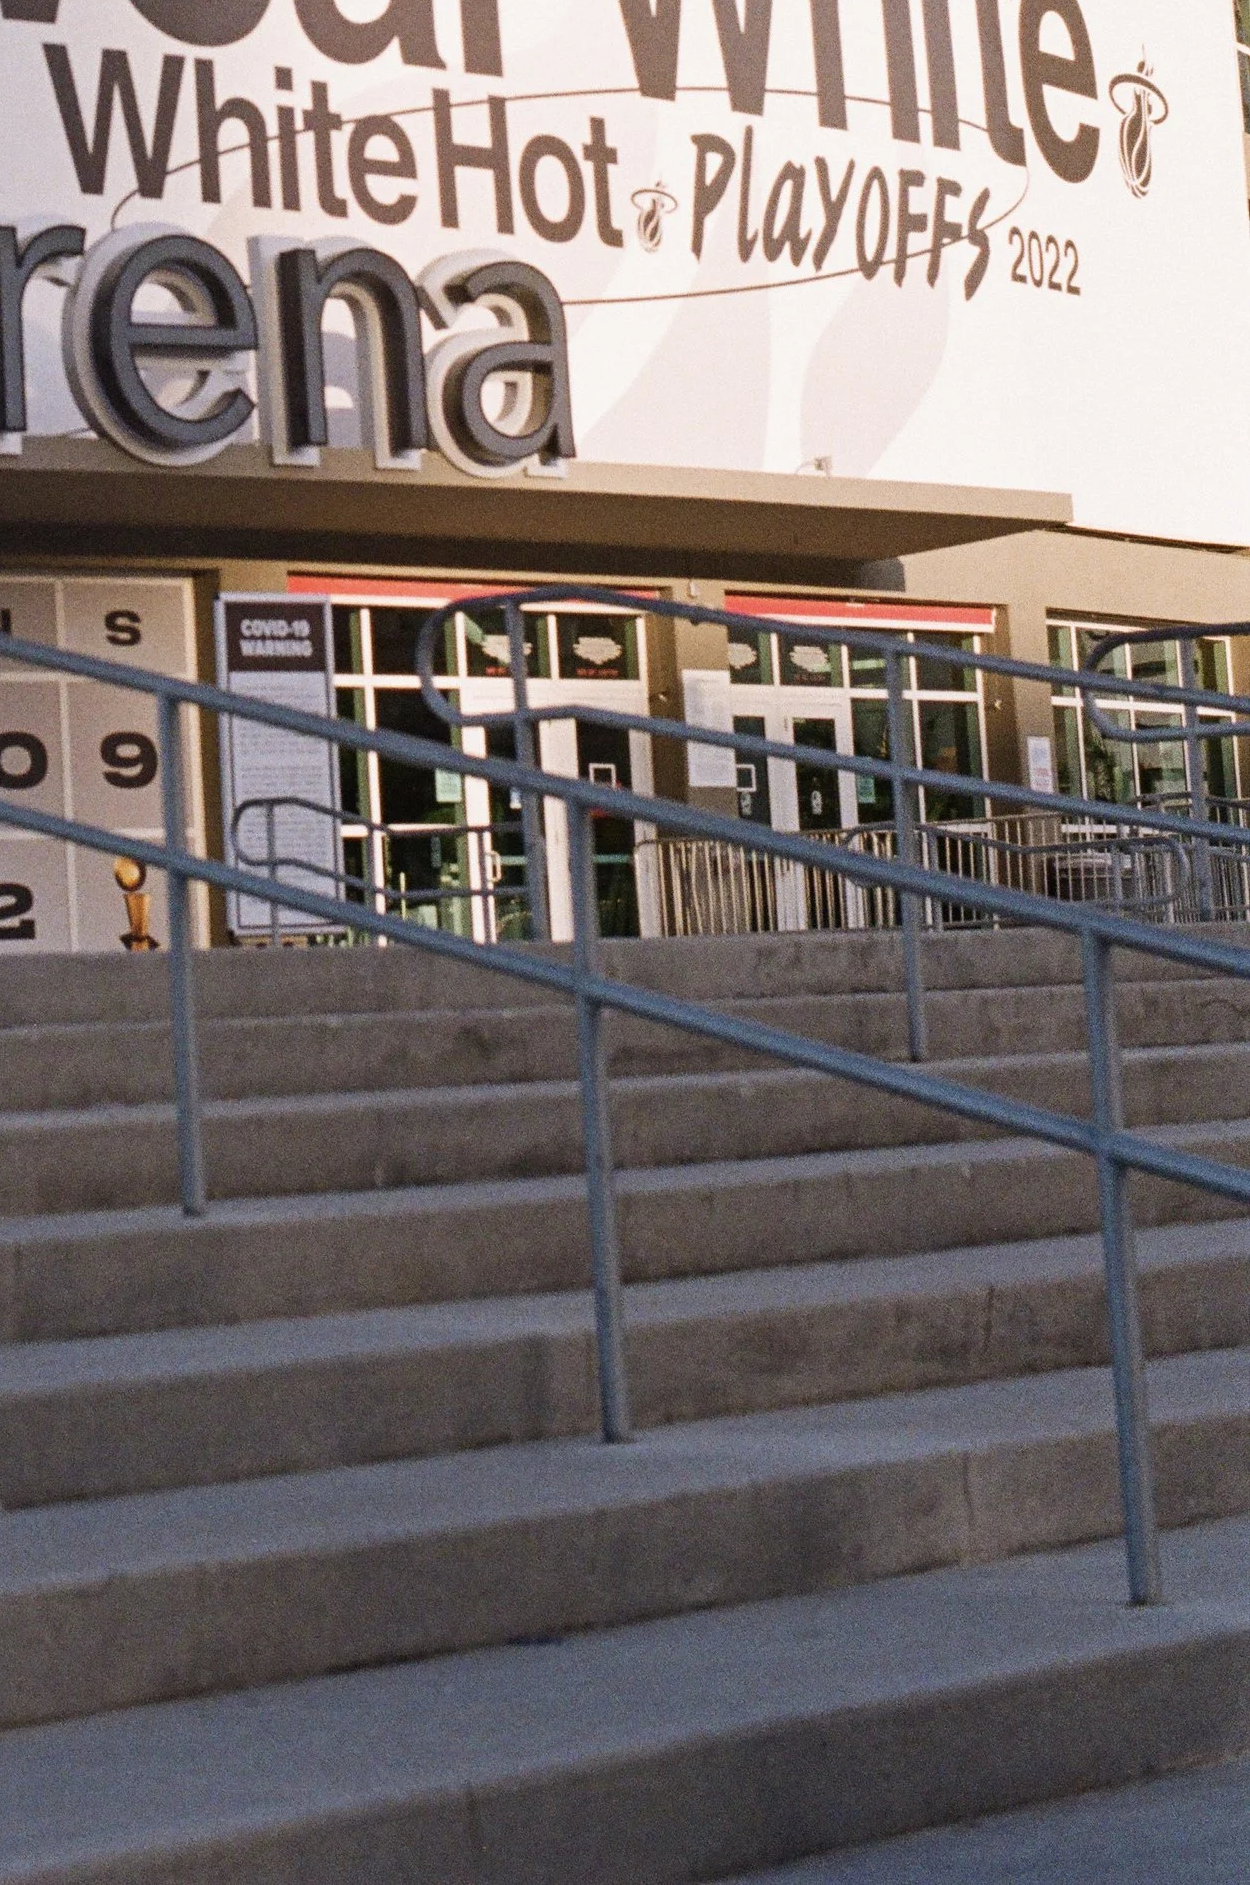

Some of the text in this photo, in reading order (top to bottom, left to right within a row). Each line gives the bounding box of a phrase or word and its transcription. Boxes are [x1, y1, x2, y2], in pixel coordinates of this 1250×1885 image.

[42, 42, 419, 226] White
[432, 86, 625, 249] Hot
[1007, 225, 1082, 297] 2022
[239, 638, 313, 658] WARNING
[240, 619, 312, 638] COVID-19
[100, 731, 159, 789] 9
